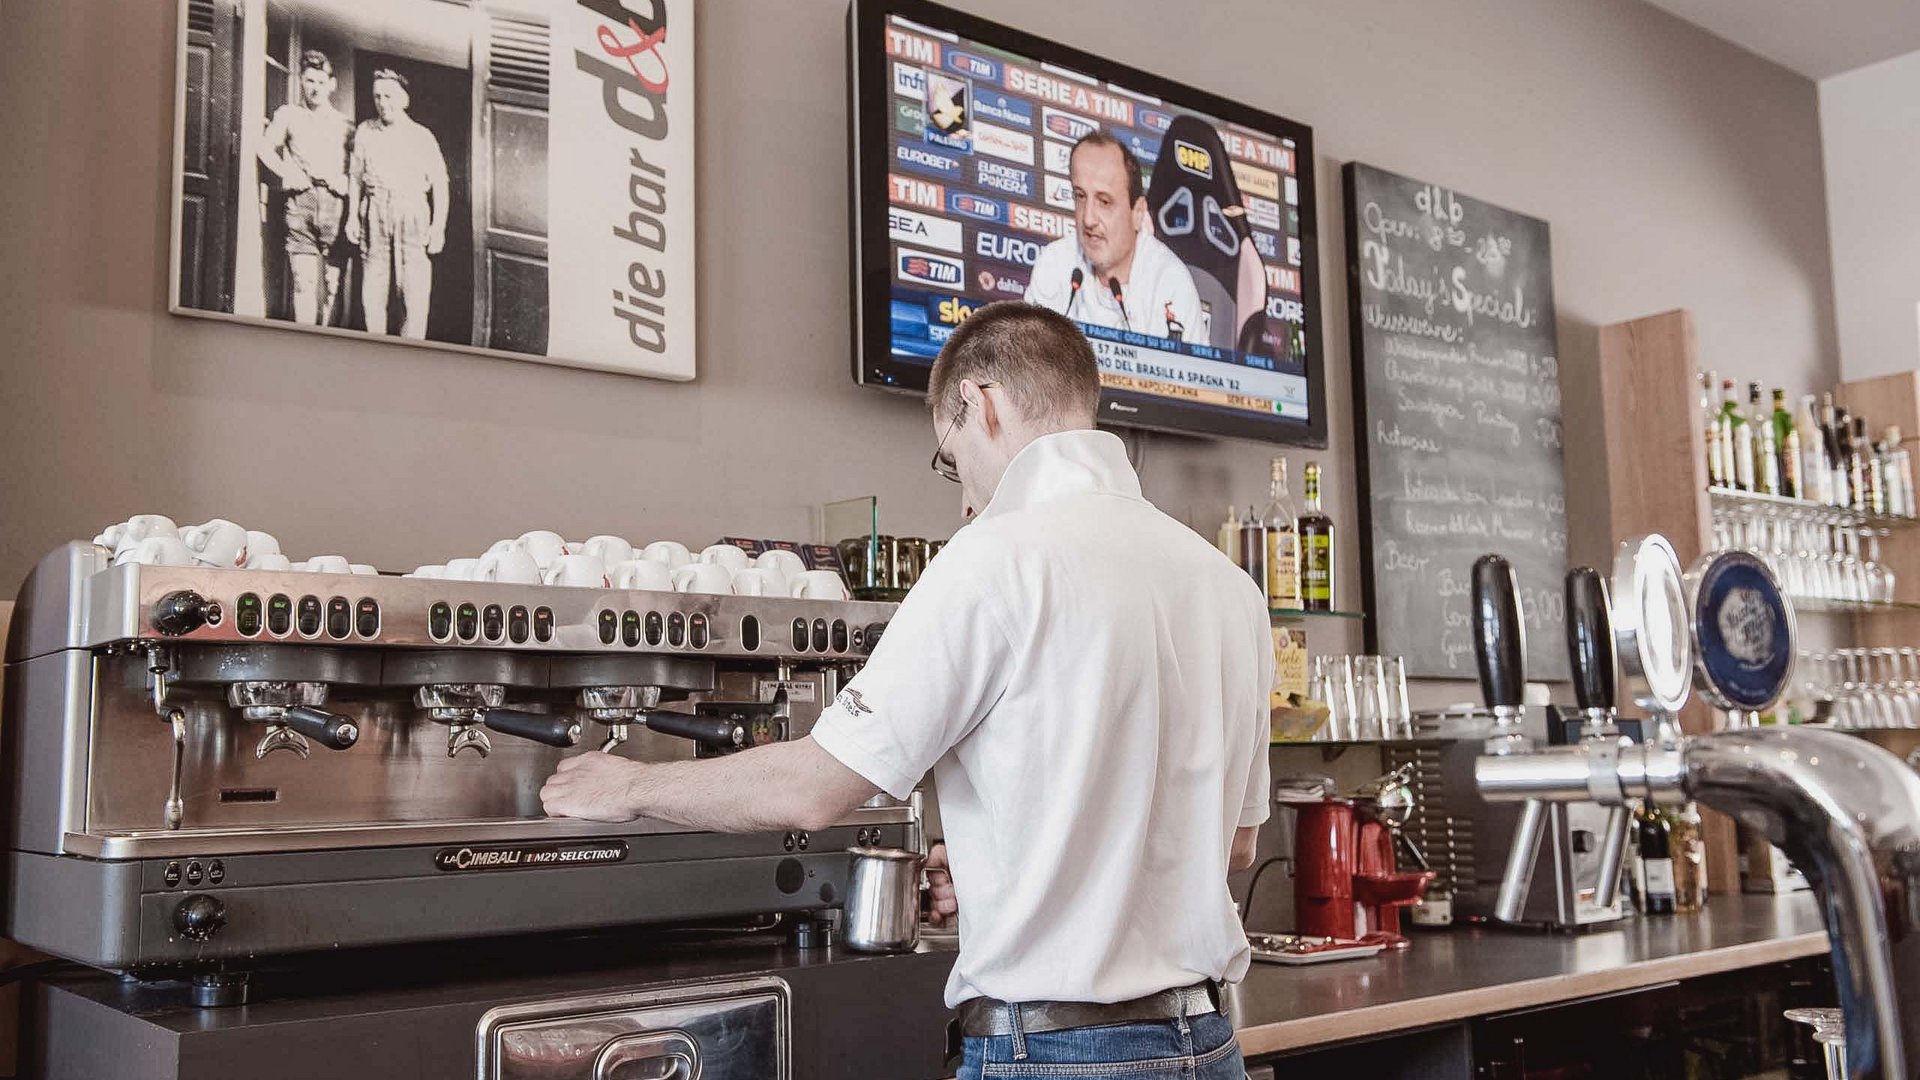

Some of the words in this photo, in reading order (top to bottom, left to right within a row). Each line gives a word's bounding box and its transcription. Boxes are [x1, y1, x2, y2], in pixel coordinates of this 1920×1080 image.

[889, 30, 935, 64] TIM
[968, 59, 991, 77] TIM
[1009, 67, 1072, 104] SERIE
[1073, 89, 1090, 111] A
[1093, 92, 1128, 122] TIM
[896, 146, 952, 171] EUROBET
[1243, 139, 1258, 161] A
[1258, 145, 1290, 170] TIM
[613, 147, 666, 253] bar
[892, 177, 938, 208] TIM
[973, 200, 996, 217] TIM
[976, 231, 1043, 266] EURO
[928, 262, 956, 283] TIM
[1264, 264, 1295, 290] TIM
[613, 262, 666, 354] die
[938, 297, 977, 324] sk
[1098, 343, 1110, 354] 57
[1114, 345, 1138, 359] ANNI
[1115, 358, 1133, 374] DEL
[1136, 362, 1175, 380] BRASILE
[1187, 372, 1225, 388] SPAGNA
[443, 855, 457, 865] LA
[456, 848, 521, 869] CIMBALI
[533, 852, 557, 863] M29
[559, 848, 622, 862] SELECTRON
